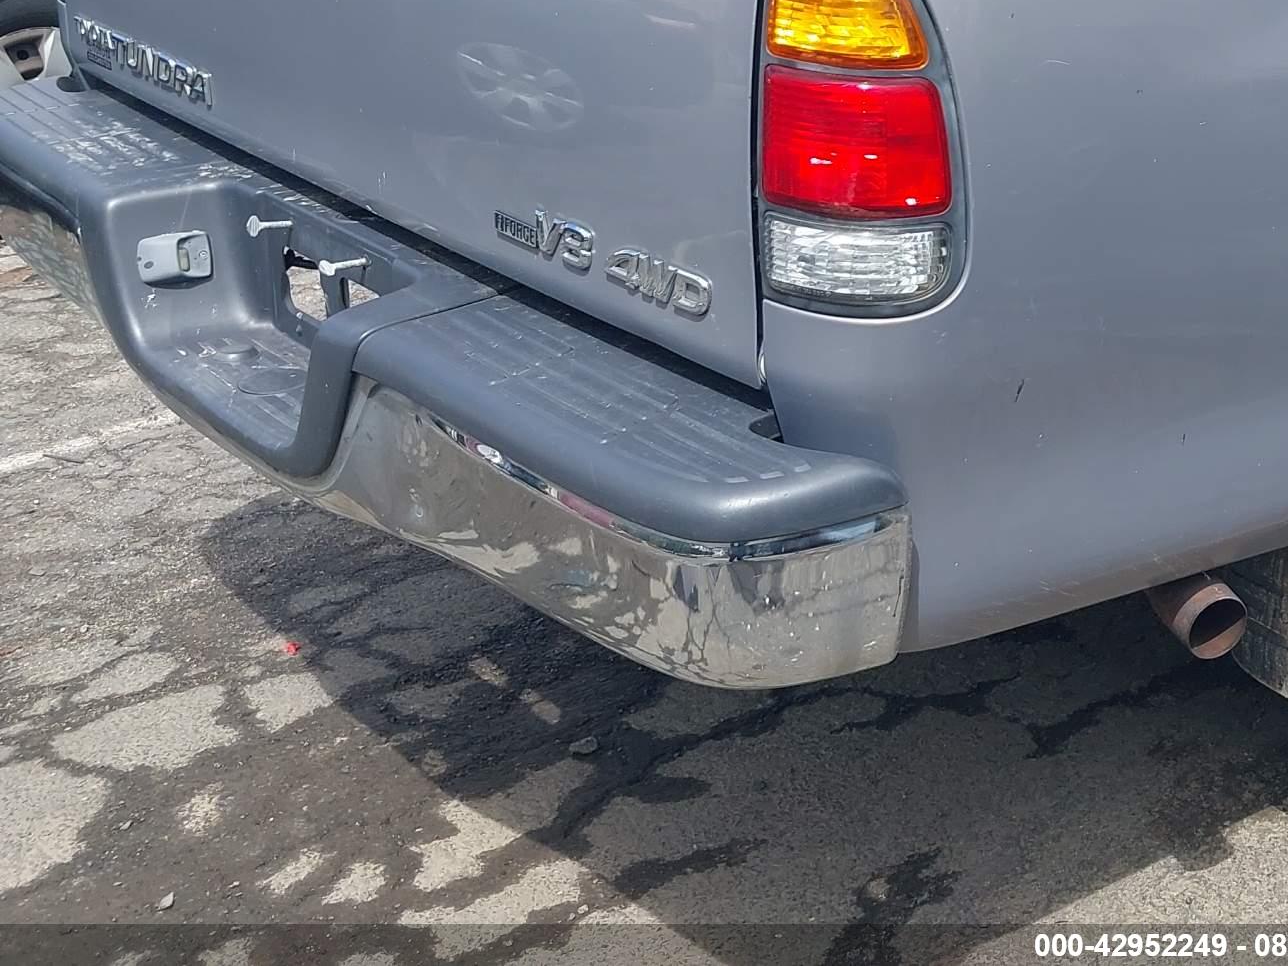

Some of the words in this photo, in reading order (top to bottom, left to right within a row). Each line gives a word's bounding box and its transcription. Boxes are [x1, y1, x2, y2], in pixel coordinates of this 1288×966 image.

[111, 32, 213, 111] TUNDRA
[535, 209, 595, 270] V8
[605, 246, 713, 317] 4WD
